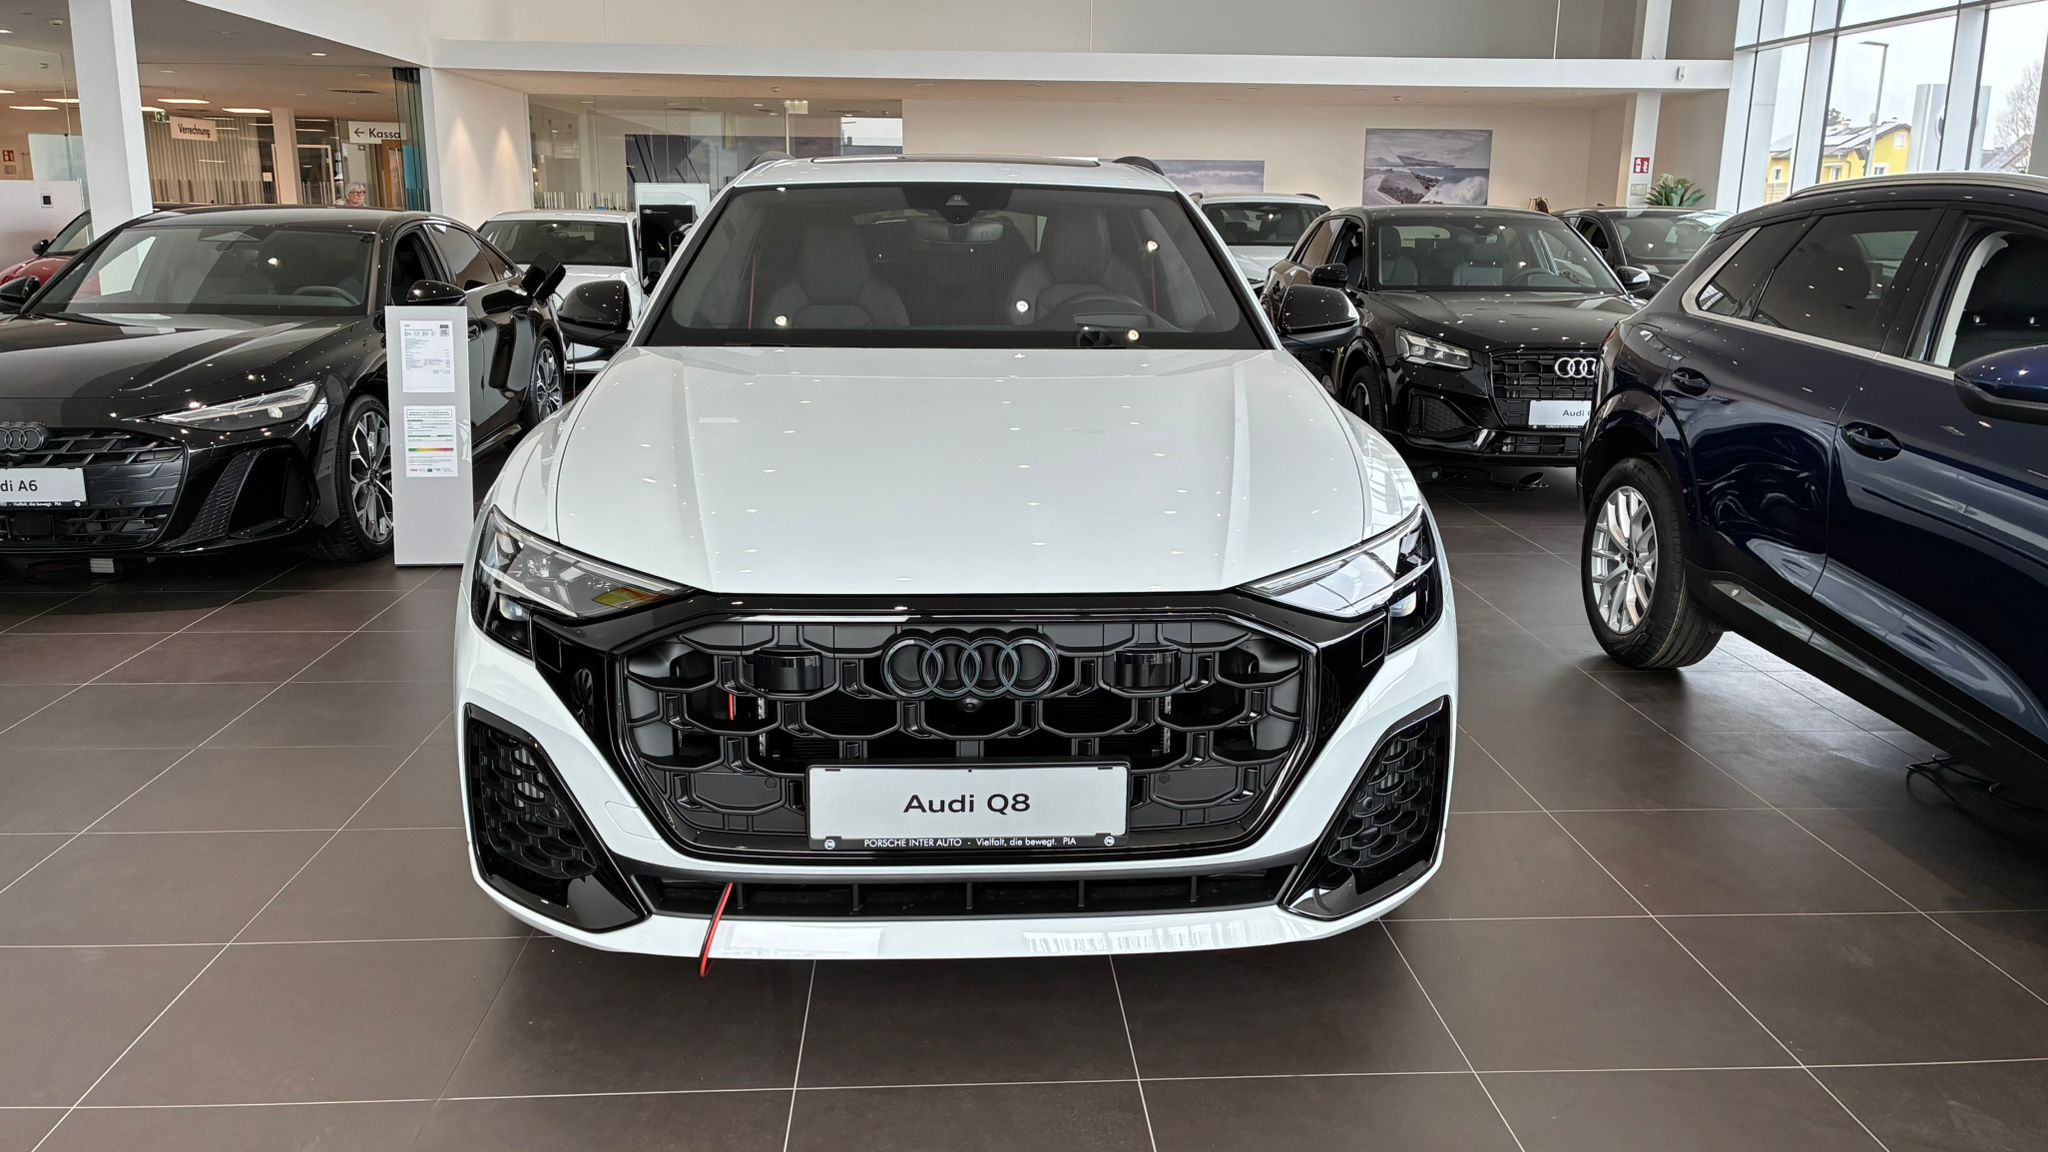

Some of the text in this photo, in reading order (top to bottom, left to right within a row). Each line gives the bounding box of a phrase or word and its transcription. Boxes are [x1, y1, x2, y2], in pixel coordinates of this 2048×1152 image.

[368, 127, 401, 139] Kassa
[1562, 409, 1585, 417] Audi
[18, 480, 38, 492] A6
[903, 793, 1031, 816] Audi Q8
[864, 836, 1077, 848] PORSCHE INTER AUTO Vielfalt, die bewegt. PIA
